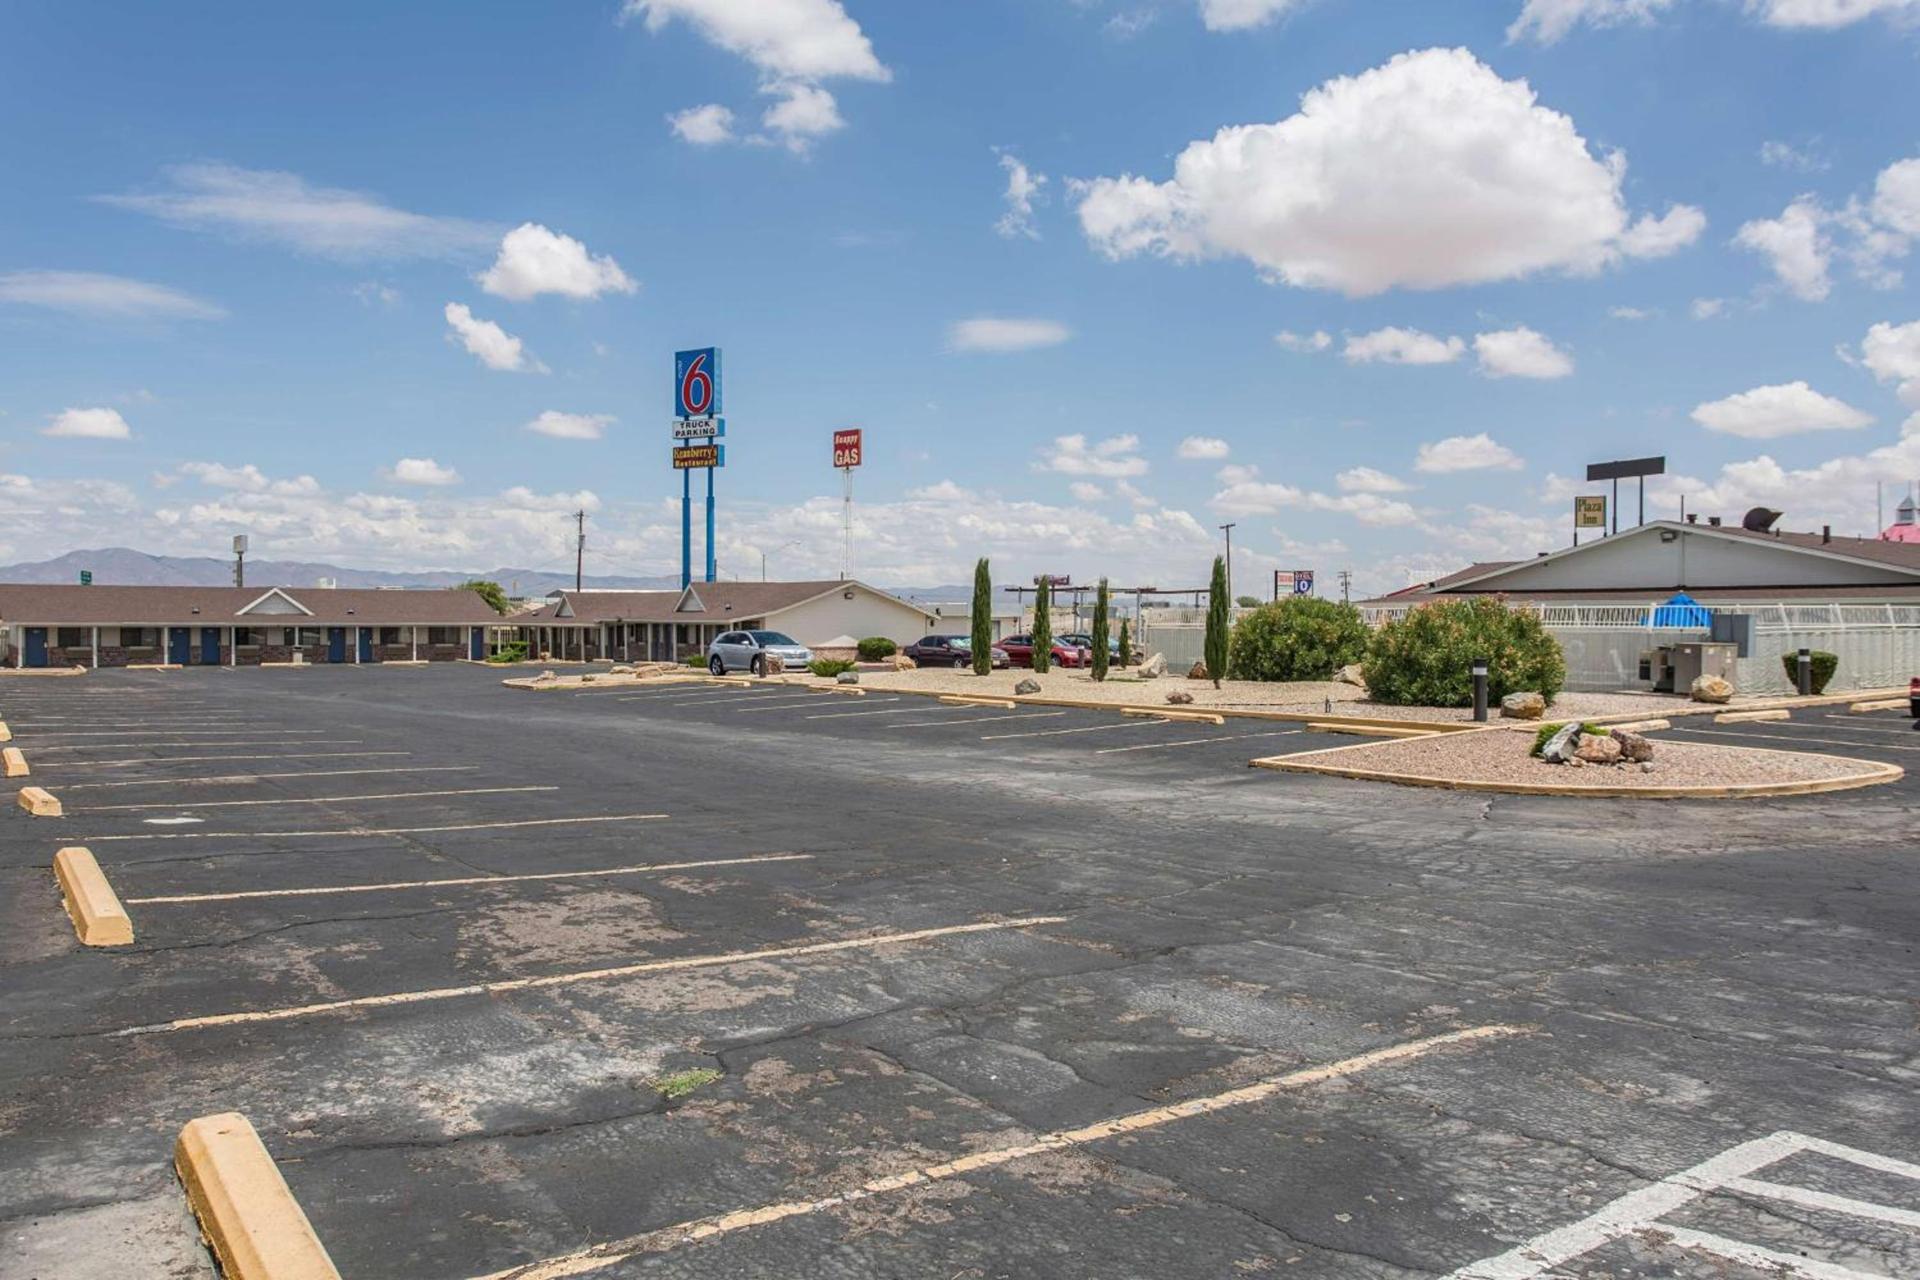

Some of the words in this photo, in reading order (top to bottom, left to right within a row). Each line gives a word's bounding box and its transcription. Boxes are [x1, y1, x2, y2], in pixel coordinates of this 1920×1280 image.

[682, 354, 712, 415] 6
[680, 421, 710, 429] TRUCK
[675, 428, 715, 437] PARKING
[835, 448, 858, 465] GAS
[1578, 498, 1602, 512] Plaza
[1583, 513, 1597, 524] Inn
